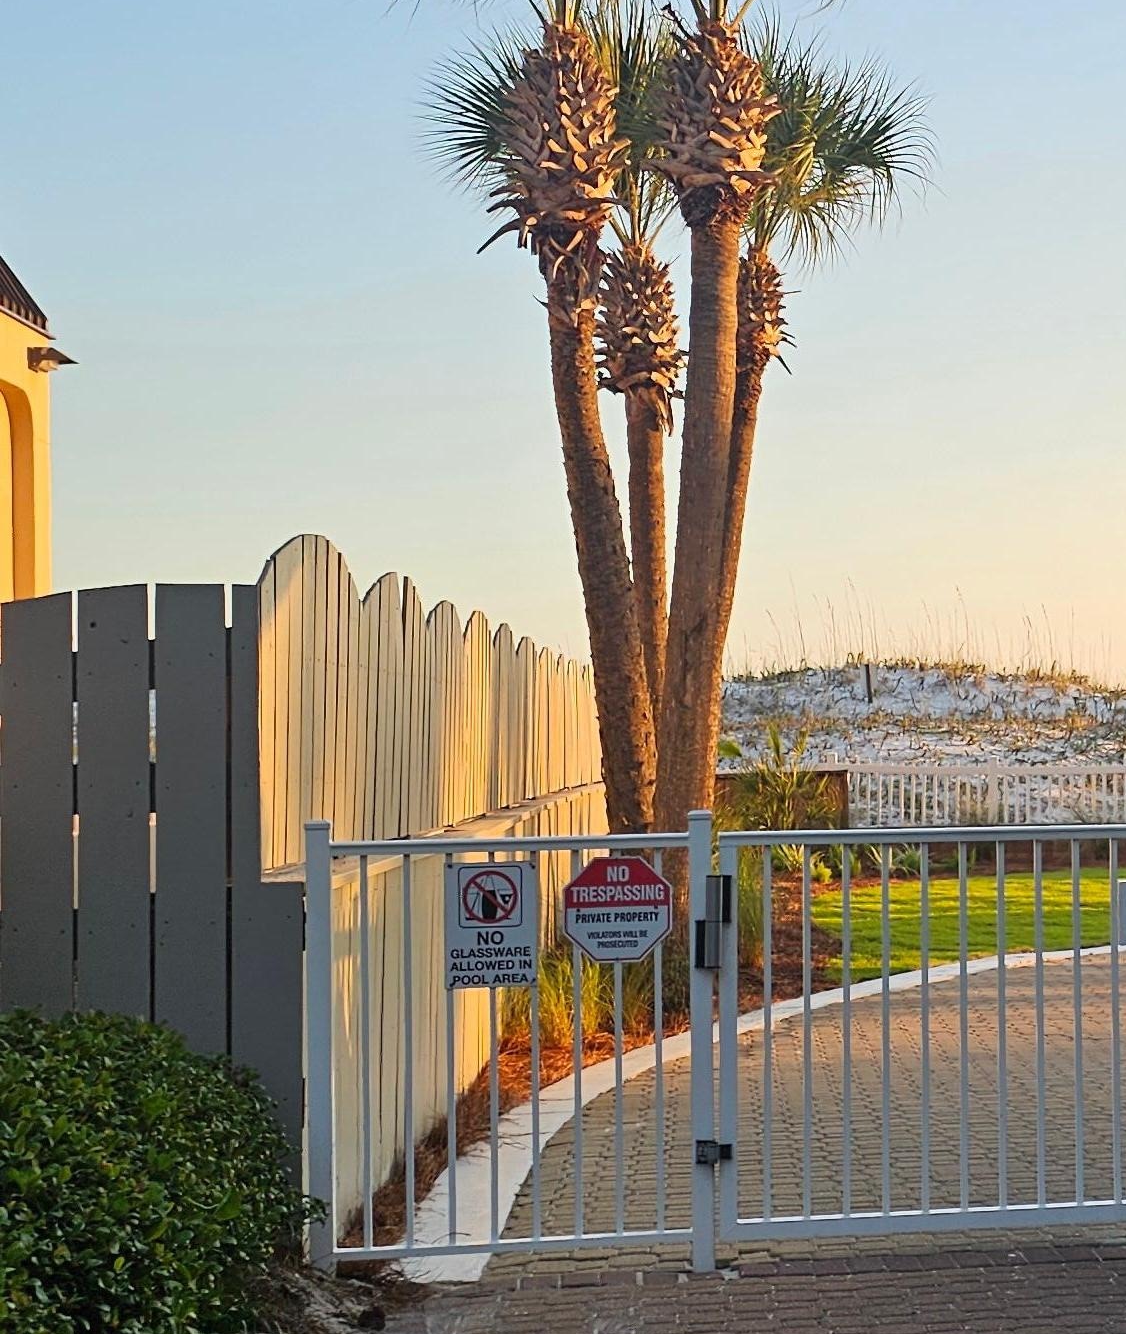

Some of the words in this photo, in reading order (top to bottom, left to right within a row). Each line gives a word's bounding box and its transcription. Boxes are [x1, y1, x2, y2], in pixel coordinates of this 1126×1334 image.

[606, 865, 630, 882] NO
[570, 884, 665, 903] TRESPASSING
[575, 913, 611, 924] PRIVATE
[614, 911, 659, 922] PROPERTY
[477, 930, 504, 945] NO
[587, 930, 622, 939] VIOLATORS
[622, 930, 638, 938] WILL
[639, 929, 648, 937] BE
[597, 939, 639, 948] PROSECUTED
[450, 946, 531, 959] GLASSWARE
[450, 959, 515, 972] ALLOWED
[519, 959, 532, 969] IN
[453, 974, 489, 985] POOL
[492, 973, 529, 984] AREA
